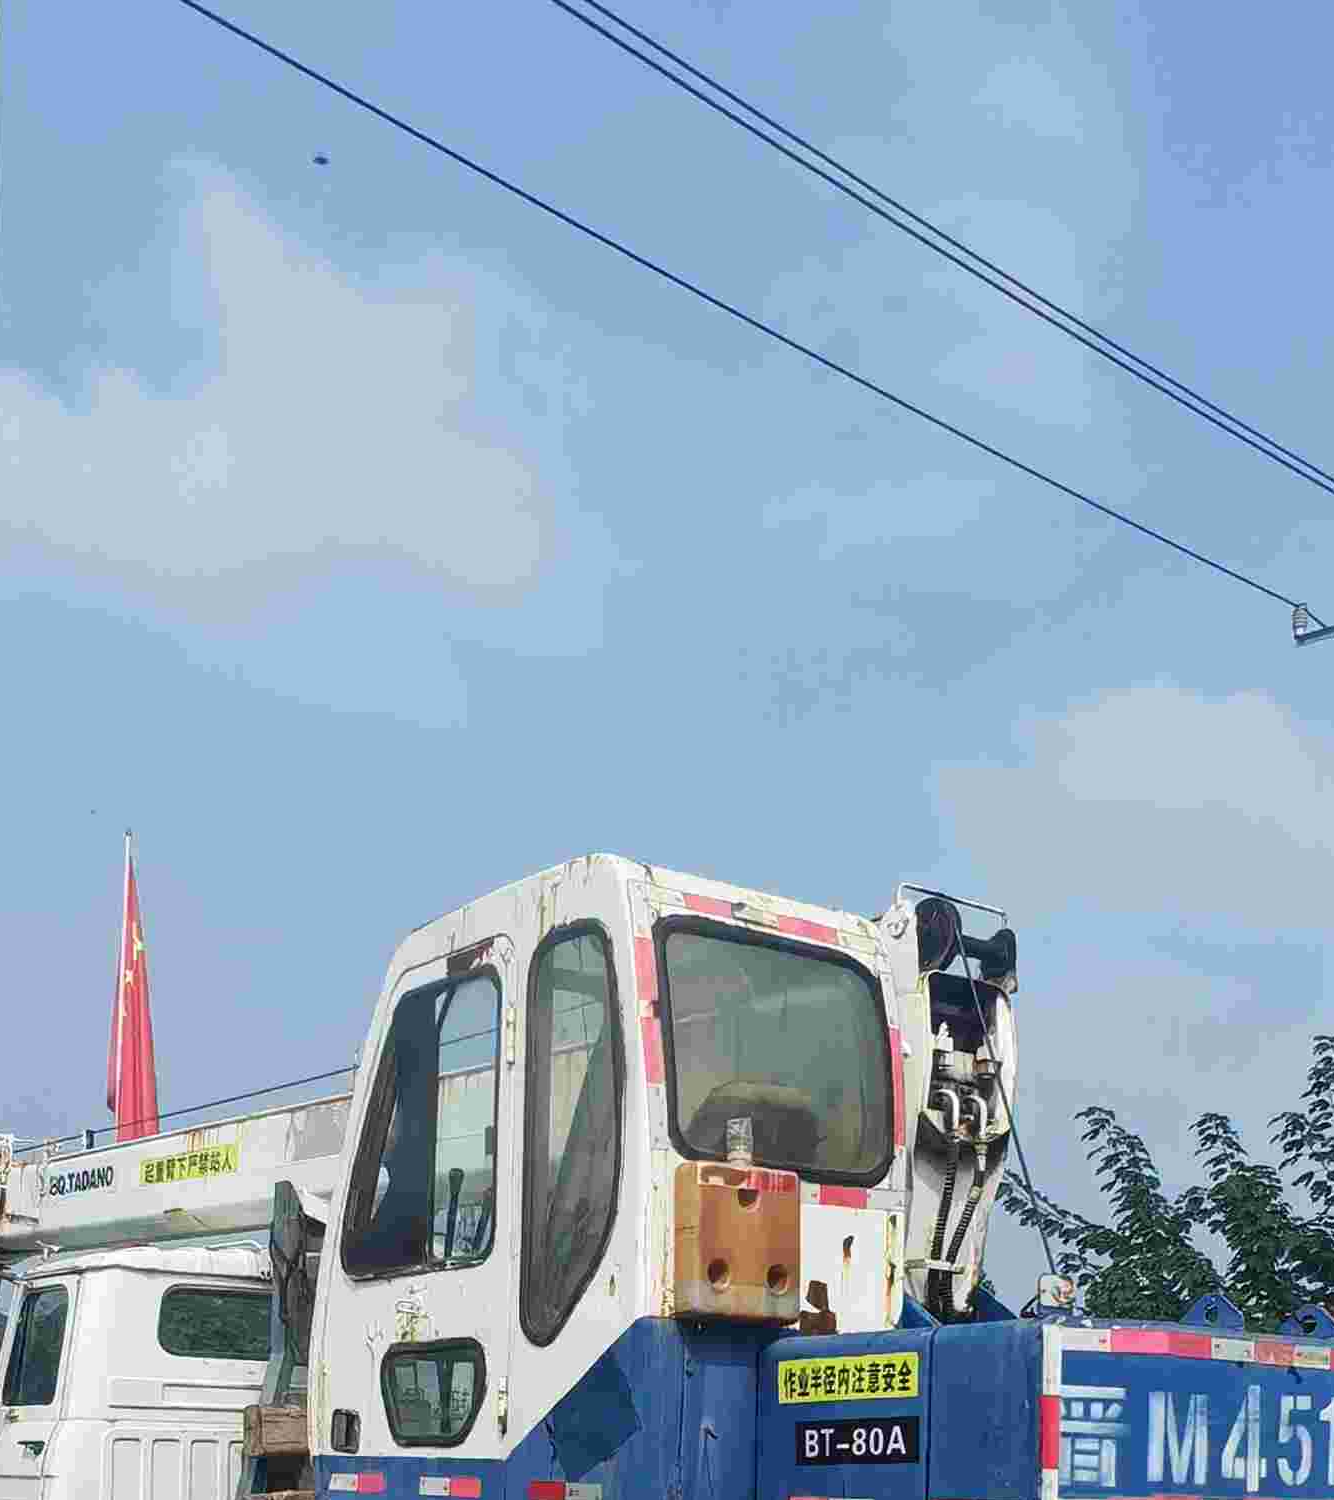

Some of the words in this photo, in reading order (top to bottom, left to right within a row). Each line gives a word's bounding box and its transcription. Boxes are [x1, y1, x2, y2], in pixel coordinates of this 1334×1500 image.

[783, 1360, 912, 1398] 作业半径内注意安全
[804, 1425, 907, 1458] BT-80A
